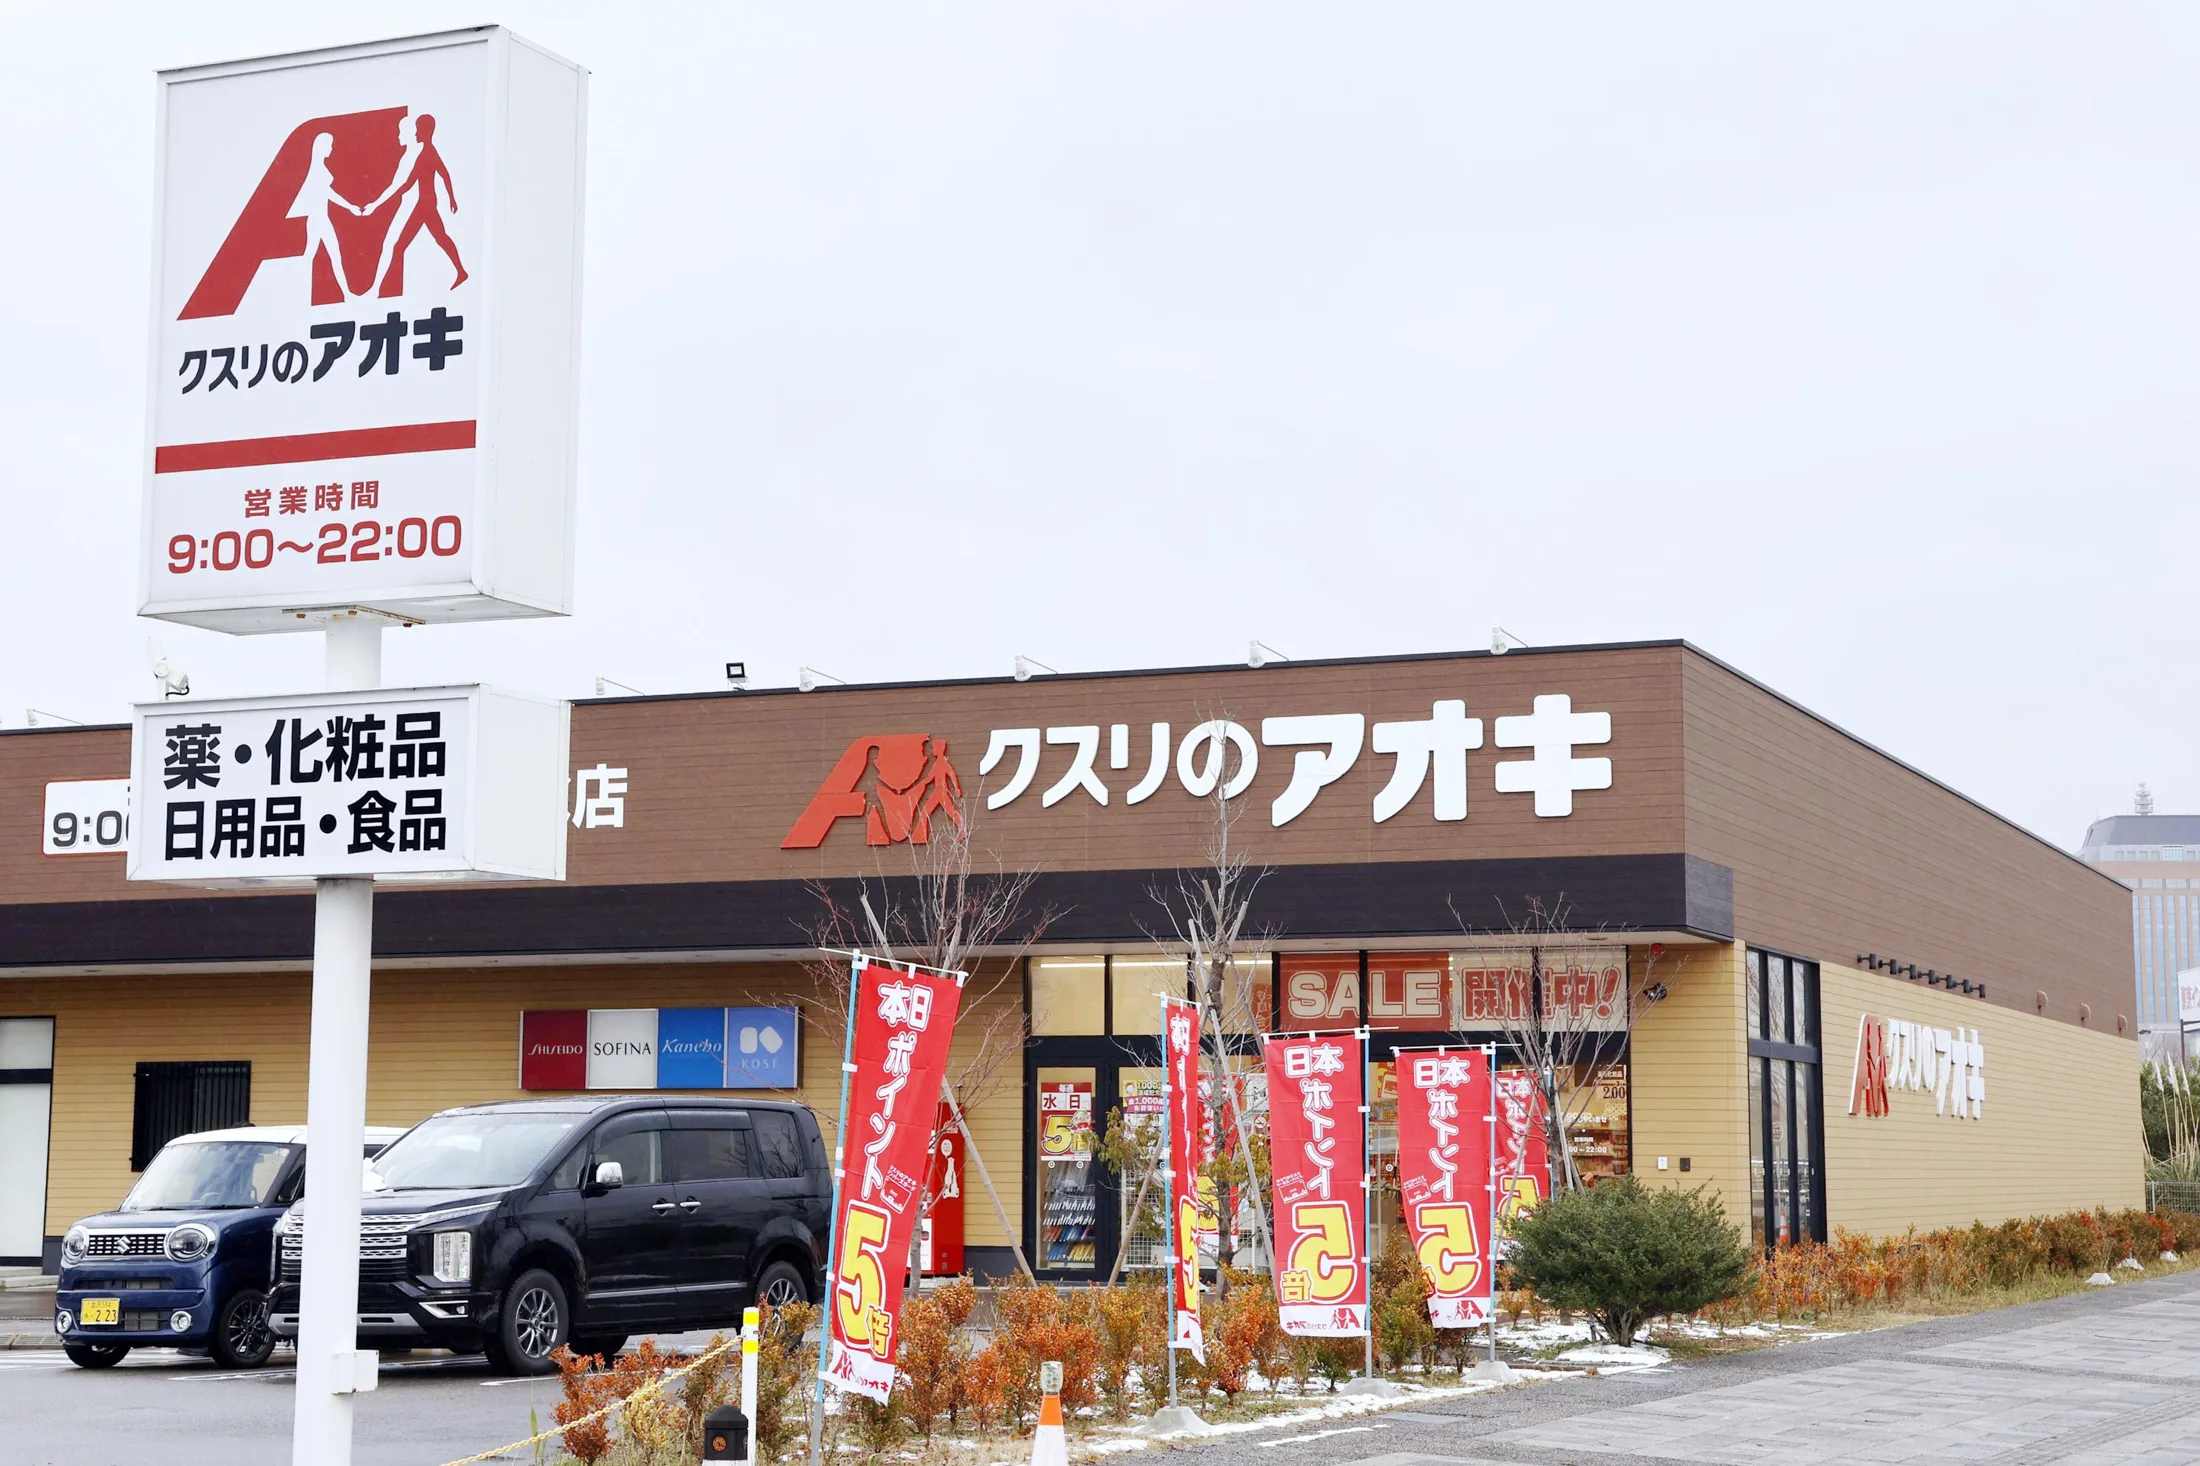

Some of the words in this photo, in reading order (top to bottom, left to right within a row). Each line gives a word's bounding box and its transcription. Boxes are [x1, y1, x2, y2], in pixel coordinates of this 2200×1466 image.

[178, 307, 463, 394] クスリのアオキ
[244, 480, 380, 518] 営業時間
[164, 711, 446, 791] 薬・化粧品
[979, 693, 1613, 828] クスリのアオキ
[568, 763, 628, 829] 店
[52, 810, 130, 848] 9:0
[165, 788, 446, 861] 日用品・食品
[878, 980, 933, 1032] 本日
[1287, 970, 1443, 1019] SALE
[527, 1043, 583, 1056] SHISEIDO
[593, 1042, 652, 1056] SOFINA
[661, 1038, 722, 1054] Kanebo
[861, 1031, 916, 1201] ポイント
[1044, 1094, 1057, 1109] 水
[1070, 1094, 1080, 1109] 日
